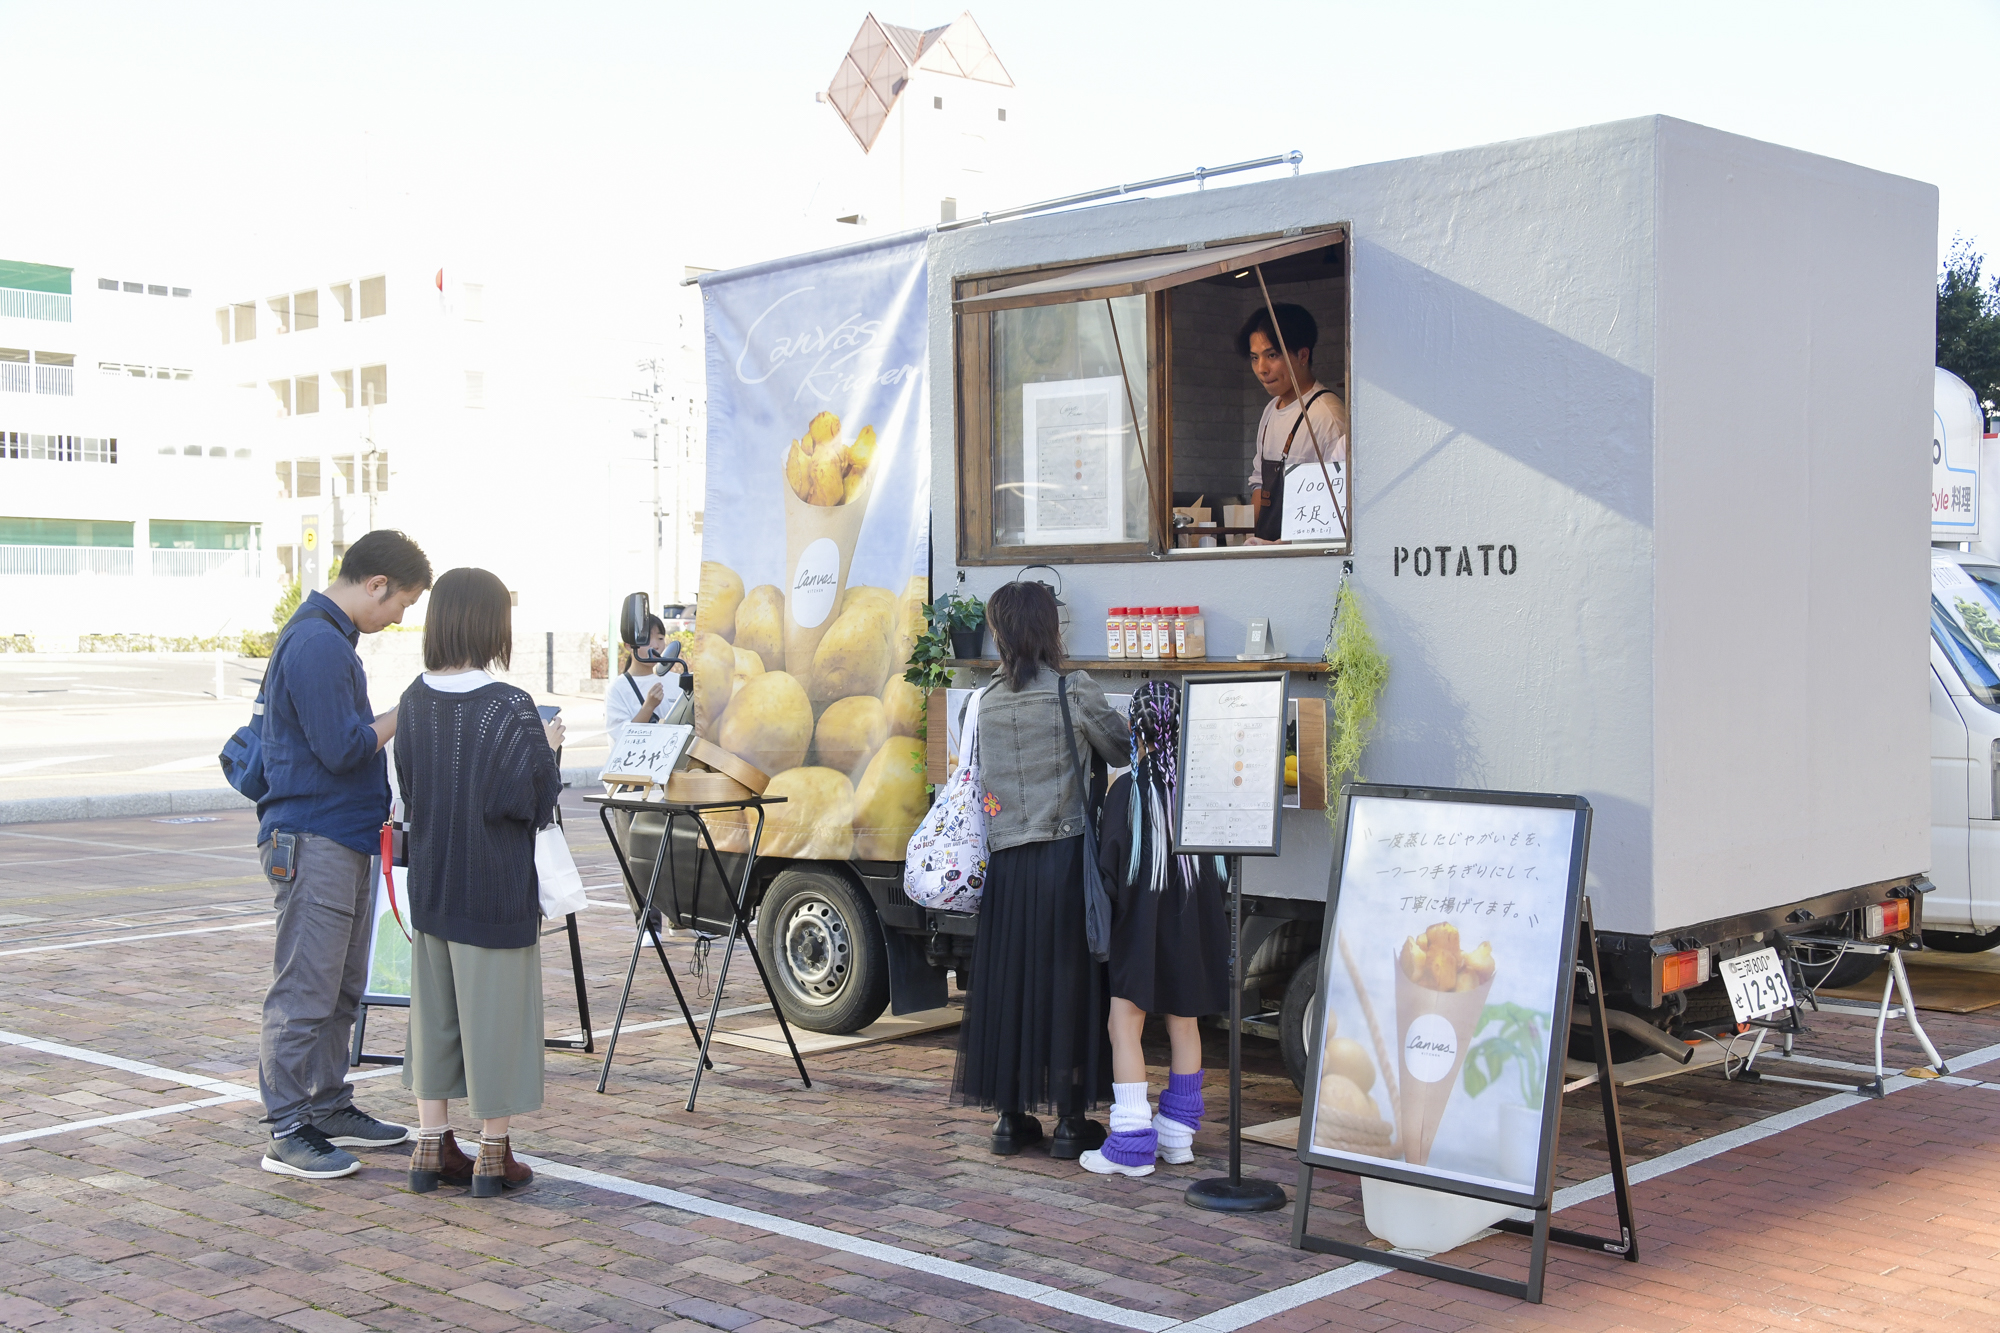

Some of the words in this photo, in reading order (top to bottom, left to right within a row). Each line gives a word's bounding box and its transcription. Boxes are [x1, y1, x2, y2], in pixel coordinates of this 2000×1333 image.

[736, 286, 882, 385] Canvas
[1950, 485, 1971, 513] 料理
[1394, 544, 1517, 577] POTATO
[794, 569, 836, 590] Canvas
[623, 749, 661, 769] とうや
[942, 815, 960, 839] TIRED
[922, 838, 936, 849] BUSY
[1377, 831, 1542, 849] 一度蒸したじゃがいもを、
[1376, 863, 1540, 881] 一つ一つ手ちぎりにして、
[1400, 895, 1519, 919] 丁寧に揚げてます。
[1743, 972, 1789, 1013] 12-93
[1406, 1035, 1455, 1054] Canvas
